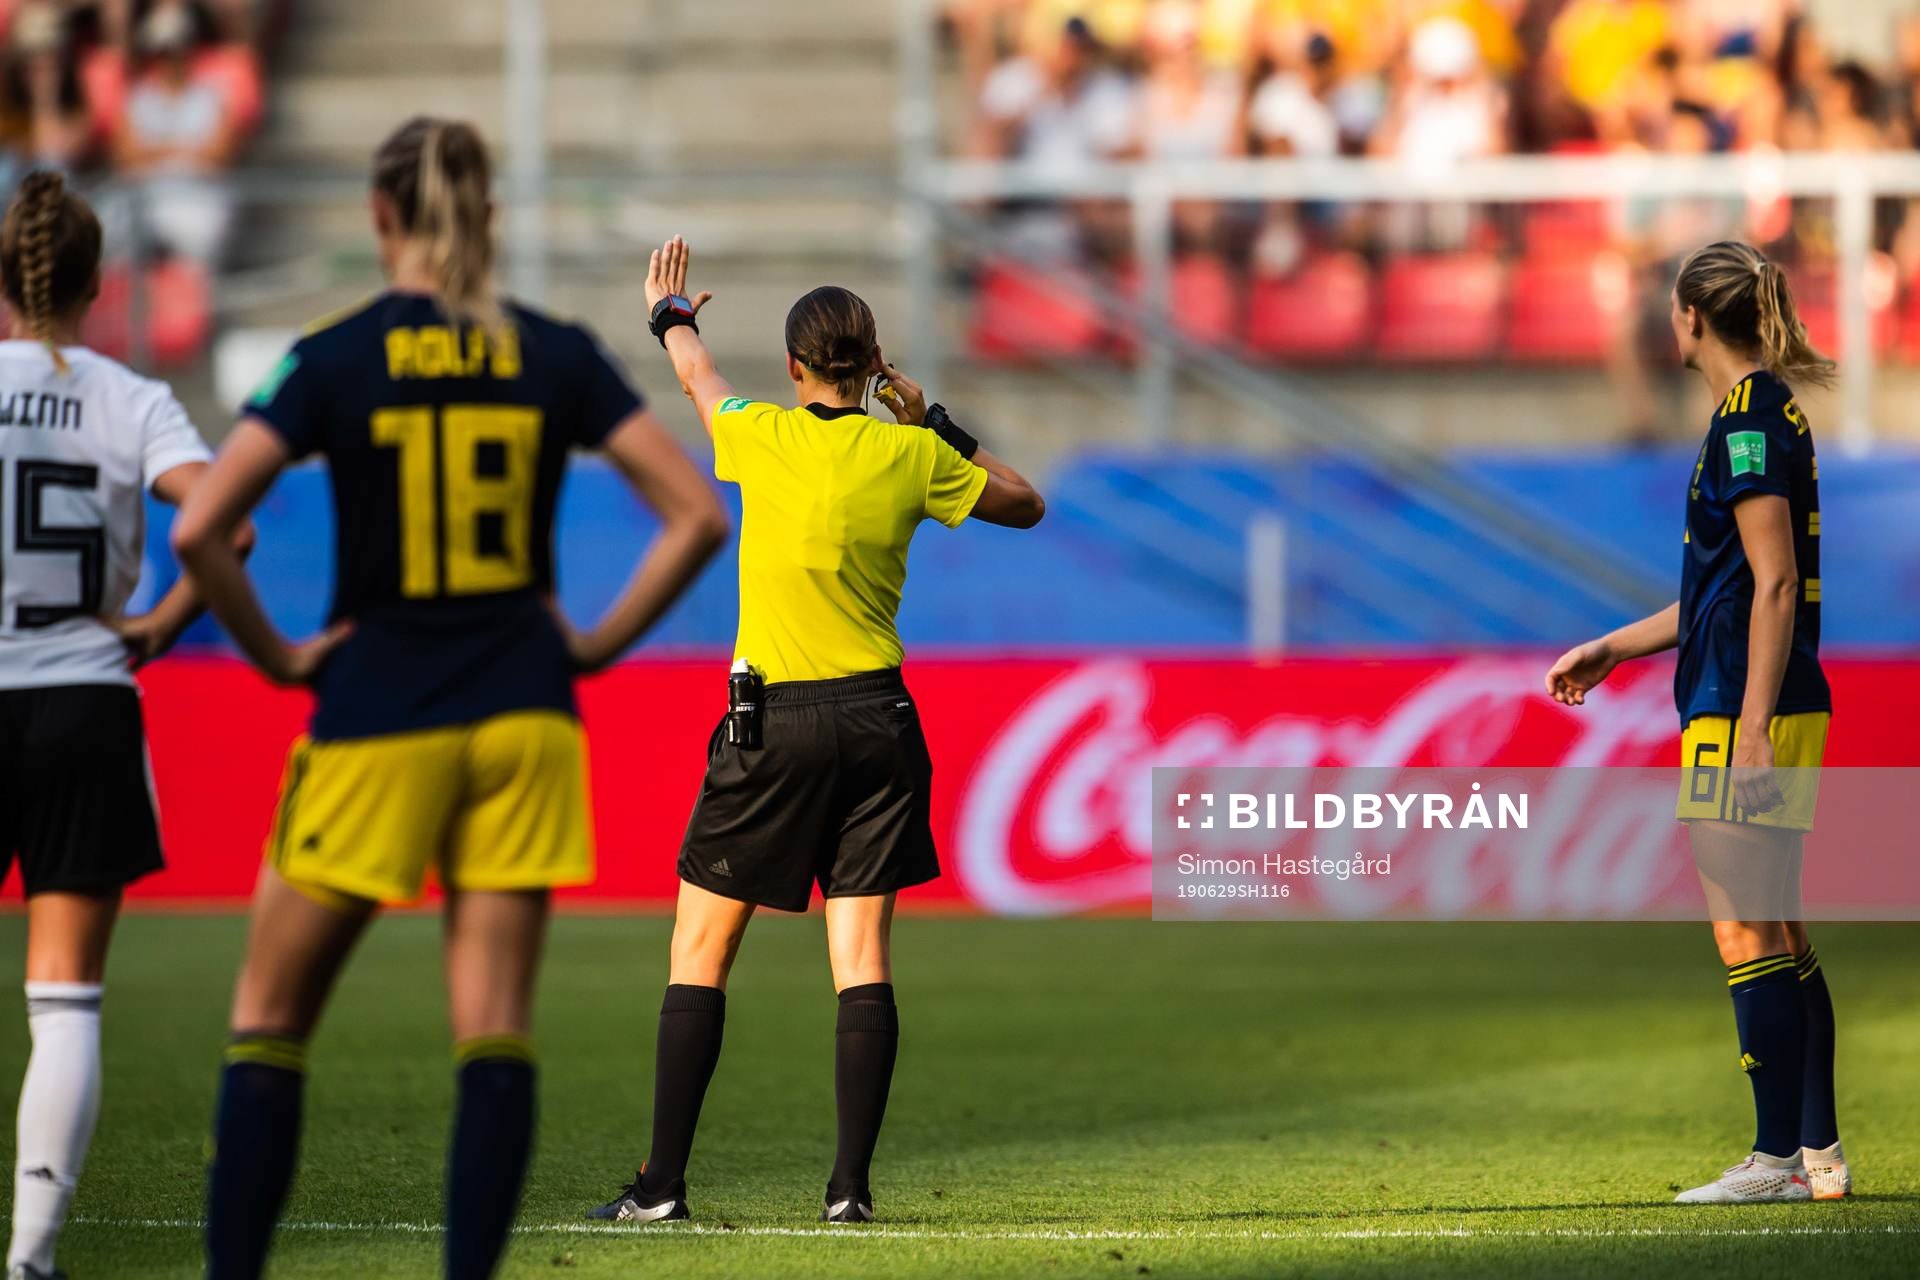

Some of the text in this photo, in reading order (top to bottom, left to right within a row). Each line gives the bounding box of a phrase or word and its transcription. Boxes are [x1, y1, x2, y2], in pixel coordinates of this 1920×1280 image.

[0, 458, 105, 628] 5
[371, 405, 543, 598] 18
[1690, 743, 1719, 803] 6
